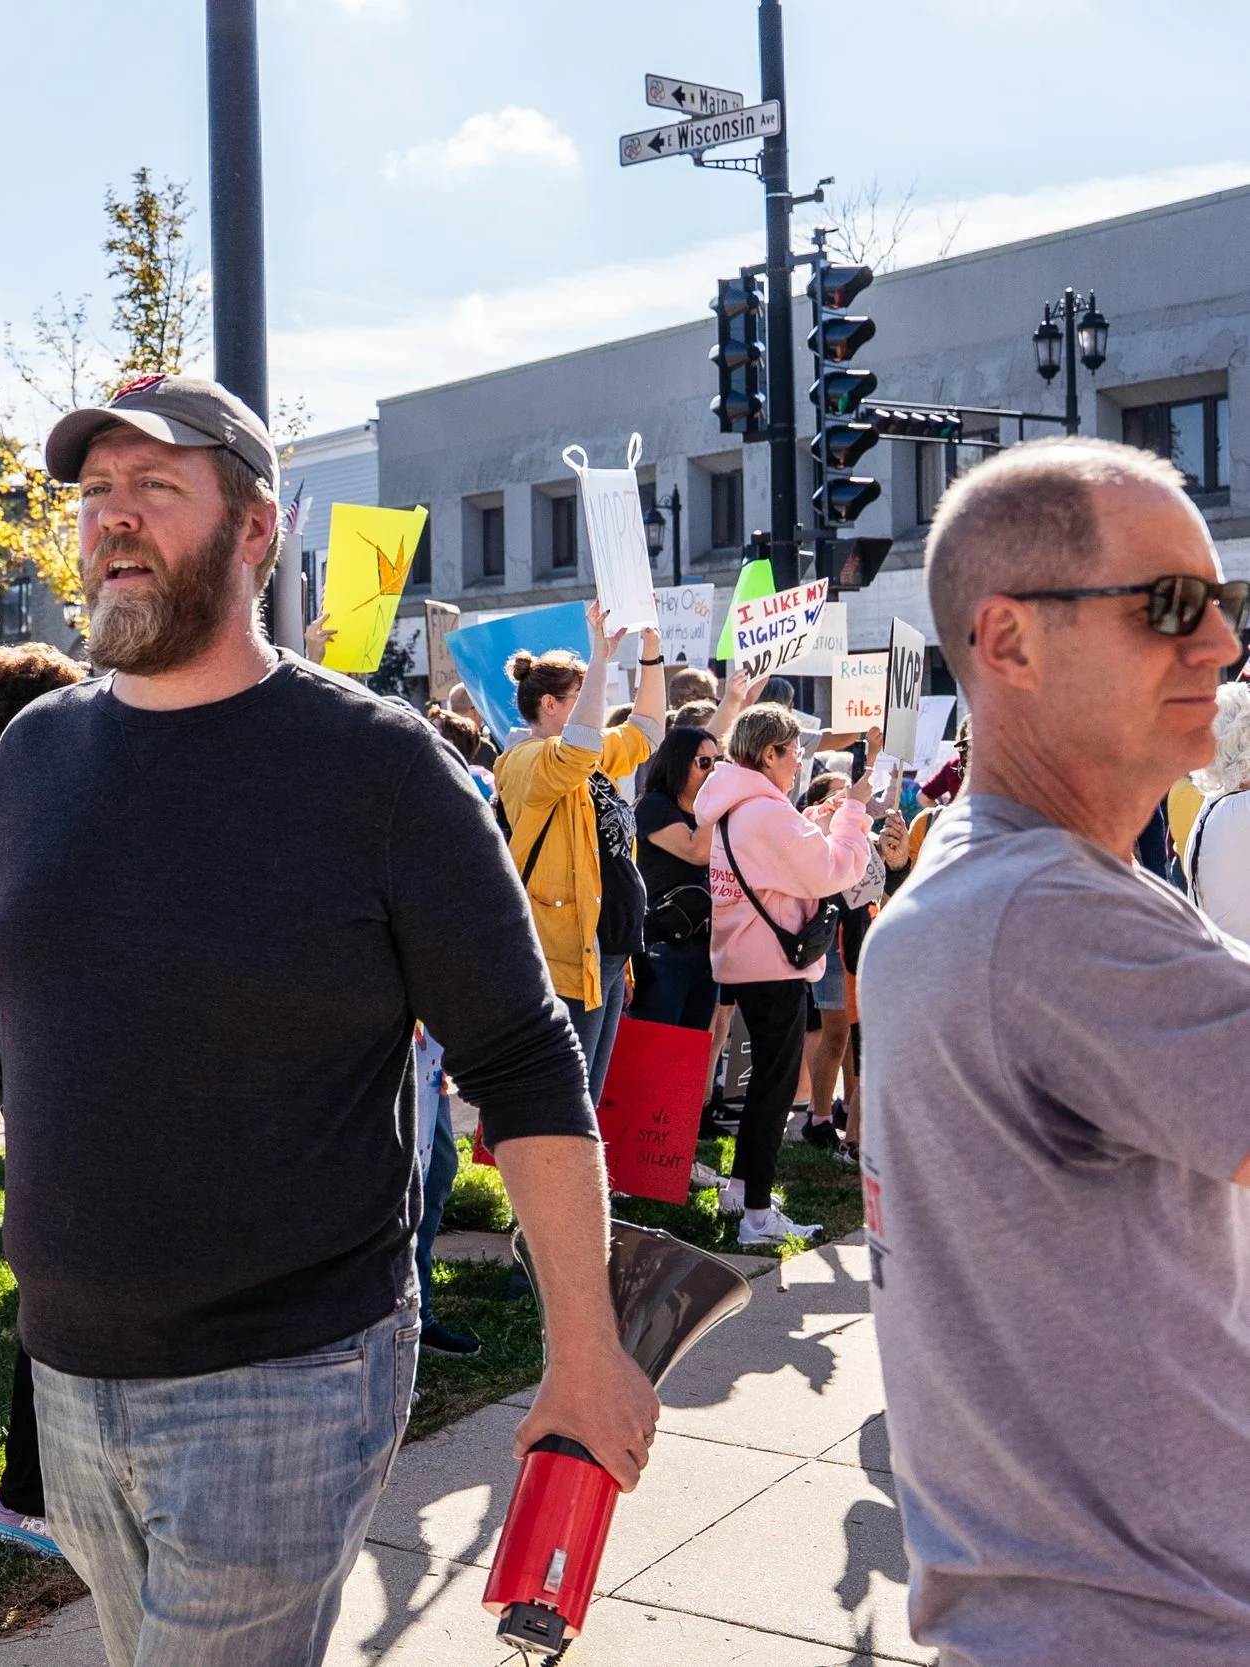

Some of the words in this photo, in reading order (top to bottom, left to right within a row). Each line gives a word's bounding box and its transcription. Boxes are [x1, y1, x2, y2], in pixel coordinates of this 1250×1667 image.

[700, 89, 728, 114] Main
[667, 134, 672, 147] E
[677, 113, 755, 149] Wisconsin
[760, 113, 775, 126] Ave
[661, 590, 679, 616] Hey
[737, 604, 754, 625] I
[763, 591, 800, 617] LIKE
[806, 580, 827, 603] MY
[737, 614, 797, 650] RIGHTS
[775, 633, 808, 669] ICE
[890, 645, 923, 712] NOP
[845, 700, 882, 718] files
[652, 1107, 670, 1124] WE
[636, 1129, 670, 1146] STAY
[635, 1151, 686, 1168] SILENT
[19, 1516, 51, 1537] HO
